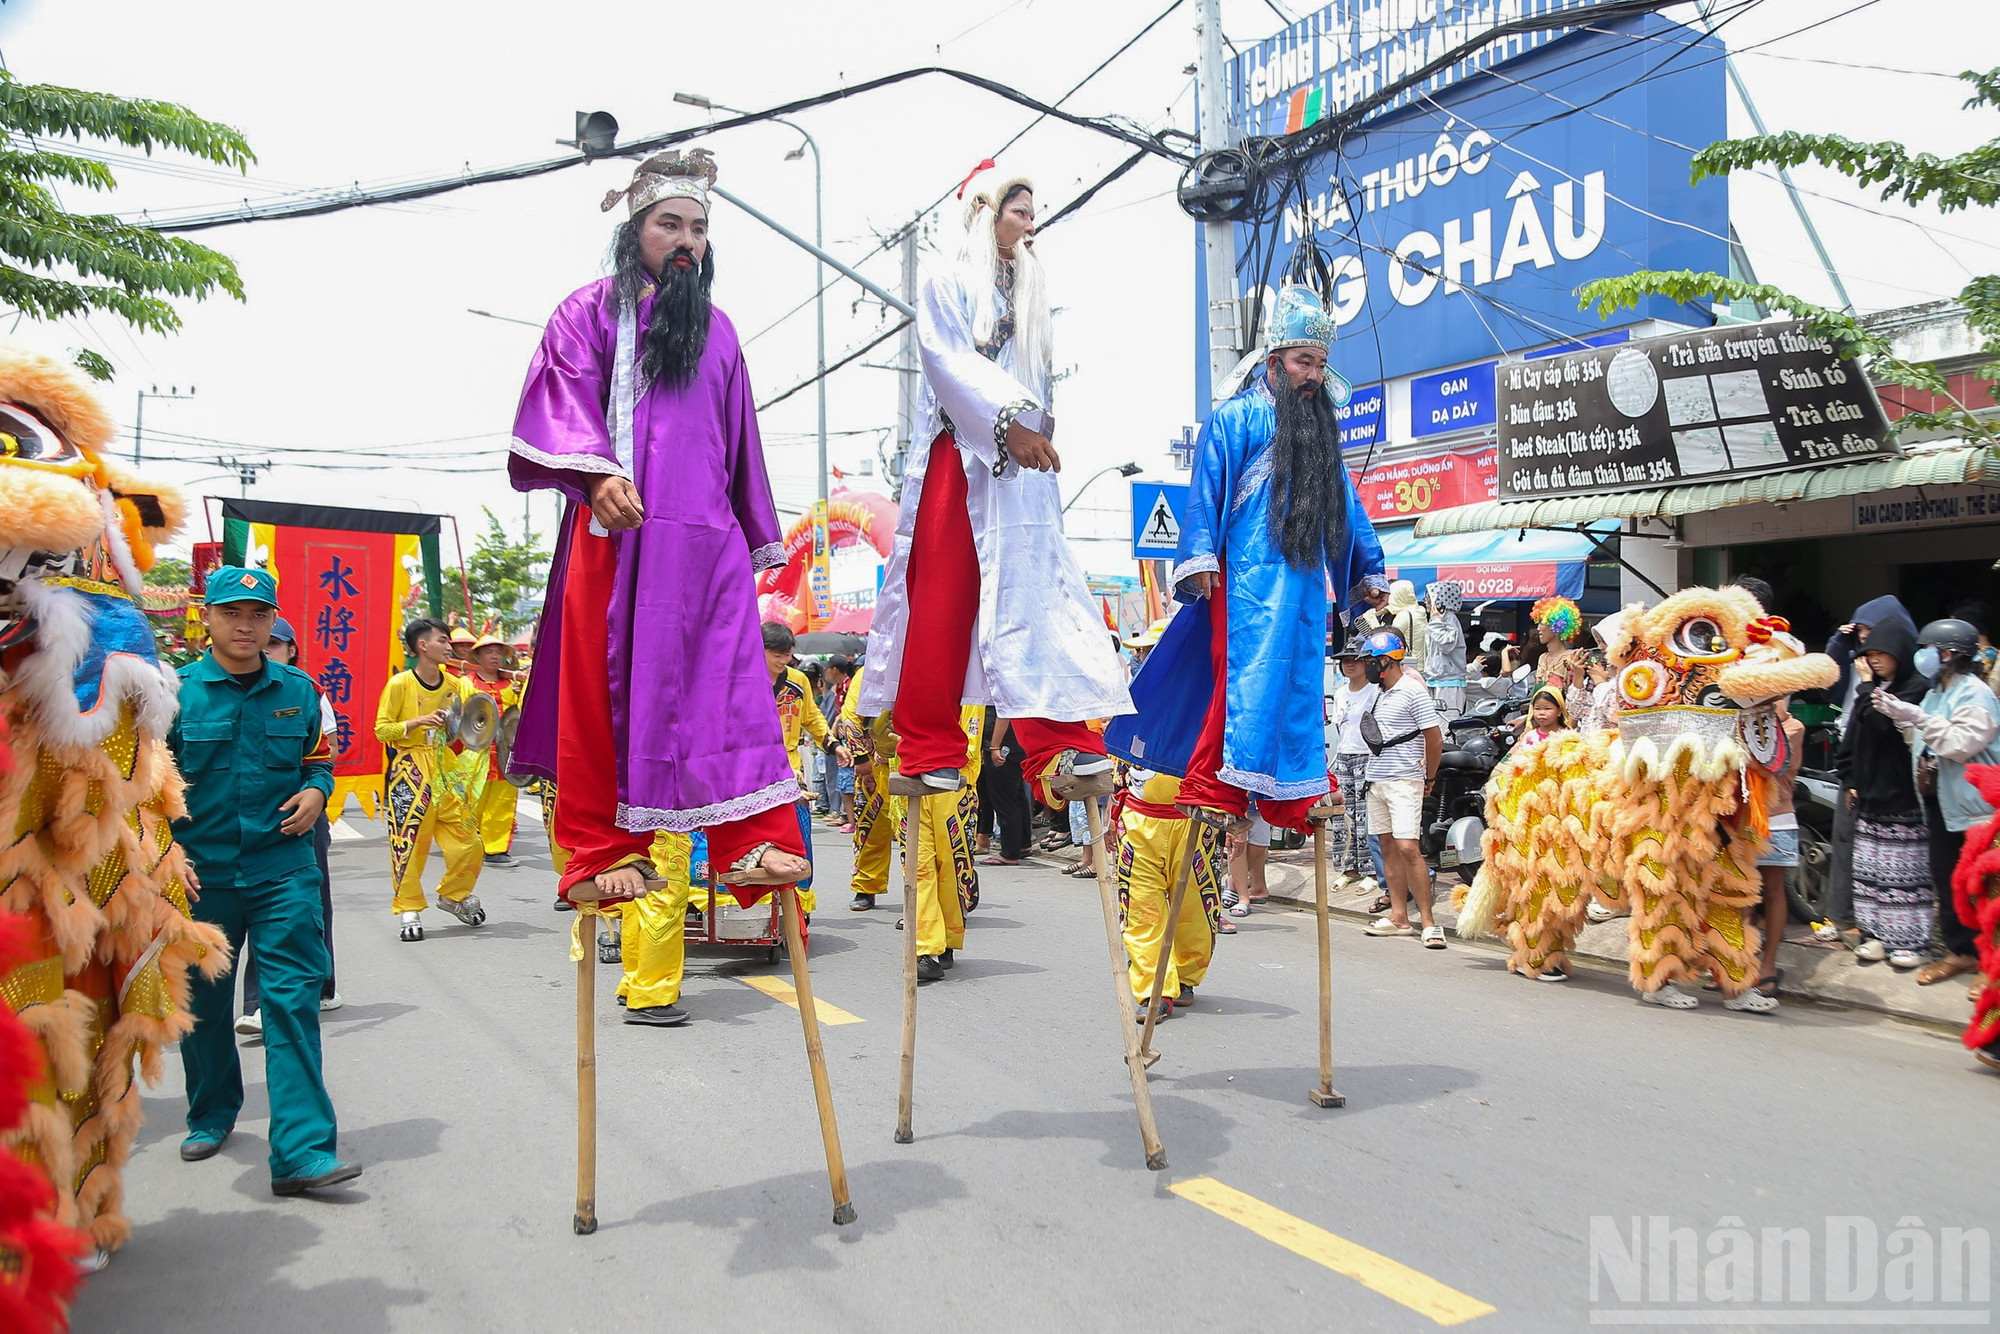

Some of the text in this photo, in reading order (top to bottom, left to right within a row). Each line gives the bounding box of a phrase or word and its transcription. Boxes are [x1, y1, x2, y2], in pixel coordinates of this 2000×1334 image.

[1362, 116, 1492, 213] THUỐC
[1388, 170, 1605, 307] CHÂU
[1724, 326, 1779, 361] truyền
[1440, 377, 1469, 397] GAN
[1523, 367, 1541, 391] Cay
[1544, 359, 1562, 389] cấp
[1564, 359, 1580, 387] độ:
[1581, 356, 1603, 382] 35k
[1779, 366, 1824, 390] Sinh
[1432, 401, 1478, 425] DẠ DÀY
[1510, 396, 1577, 427] Bún đậu: 35k
[1786, 399, 1864, 427] Trà dâu
[1350, 423, 1376, 442] KINH
[1510, 436, 1533, 459] Beef
[1535, 429, 1588, 458] Steak(Bít
[1617, 423, 1642, 450] 35k
[1801, 433, 1879, 460] Trà đào
[1477, 454, 1493, 468] MÁY
[1512, 467, 1531, 492] Gỏi
[1533, 467, 1548, 490] đu
[1568, 464, 1594, 486] đâm
[1620, 461, 1646, 482] lan:
[1647, 457, 1675, 483] 35k
[1395, 477, 1441, 513] 30%
[1488, 486, 1497, 497] ĐẾ
[1879, 502, 1903, 523] CARD
[1478, 578, 1514, 594] 6928
